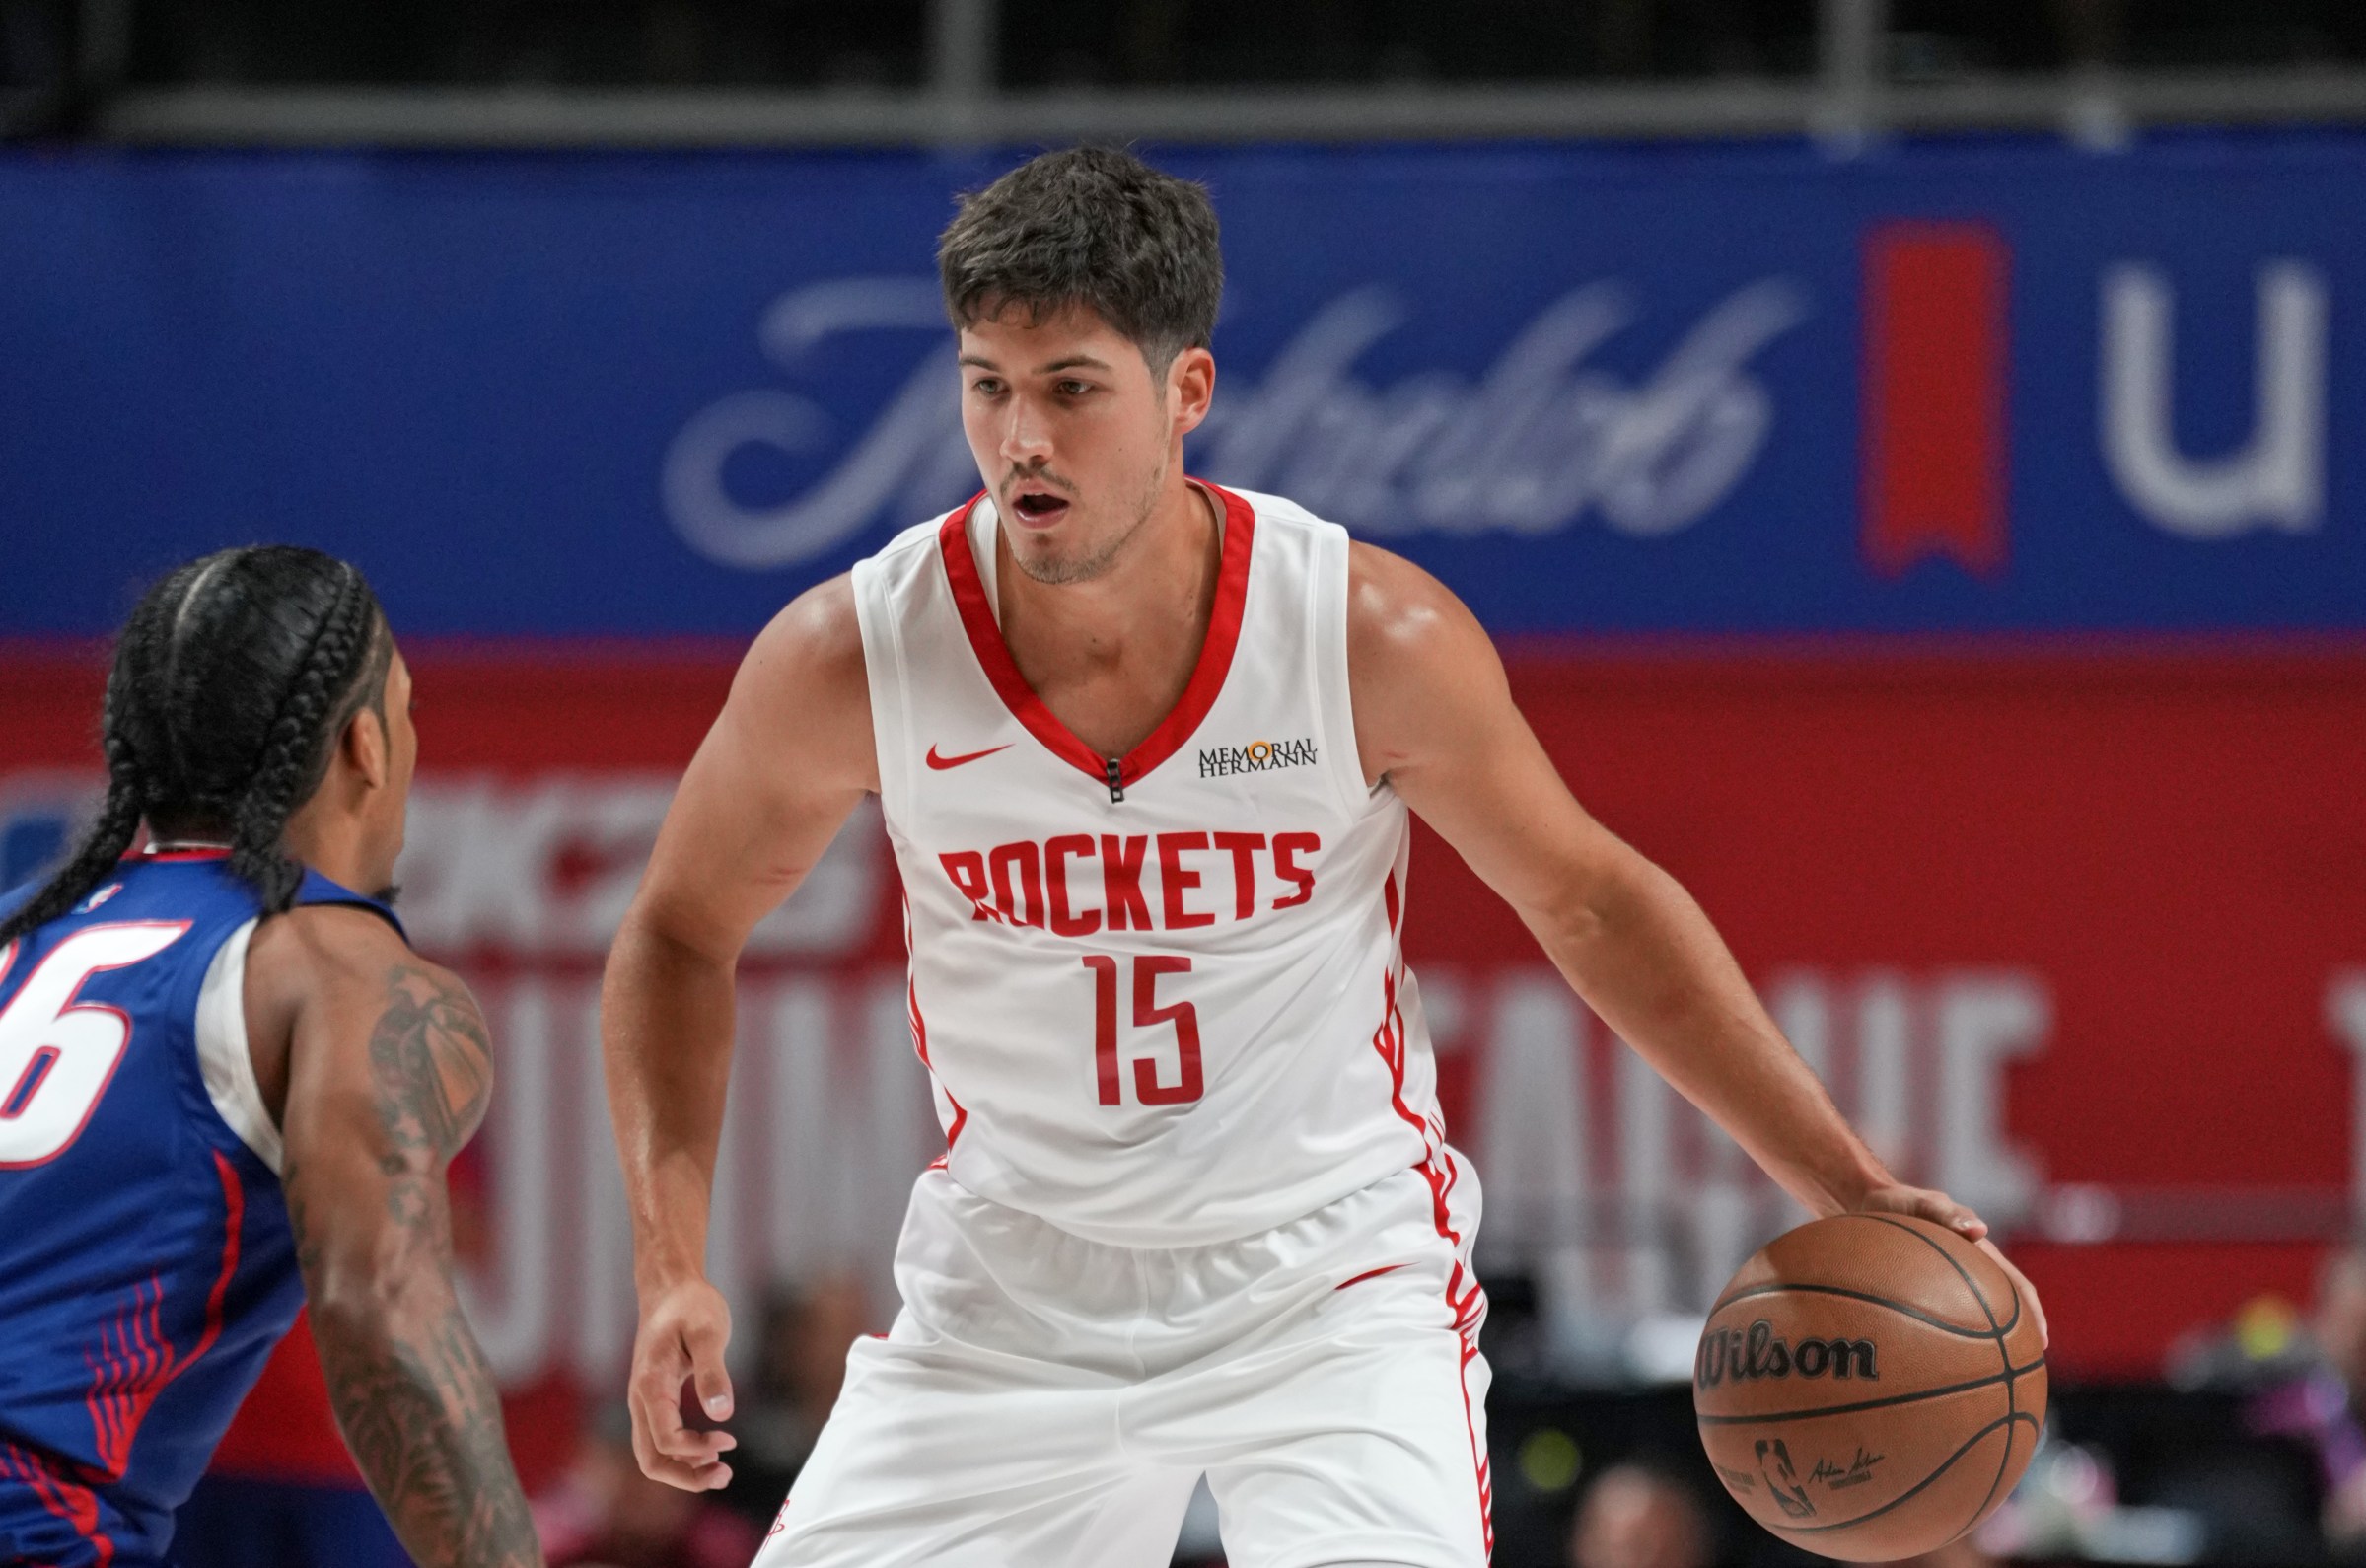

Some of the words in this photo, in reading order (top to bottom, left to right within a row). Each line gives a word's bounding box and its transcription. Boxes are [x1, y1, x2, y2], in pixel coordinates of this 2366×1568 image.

[1199, 738, 1318, 766] MEMORIAL
[1199, 751, 1317, 778] HERMANN
[938, 831, 1321, 937] ROCKETS
[1082, 955, 1204, 1106] 15
[1697, 1318, 1879, 1393] Wilson
